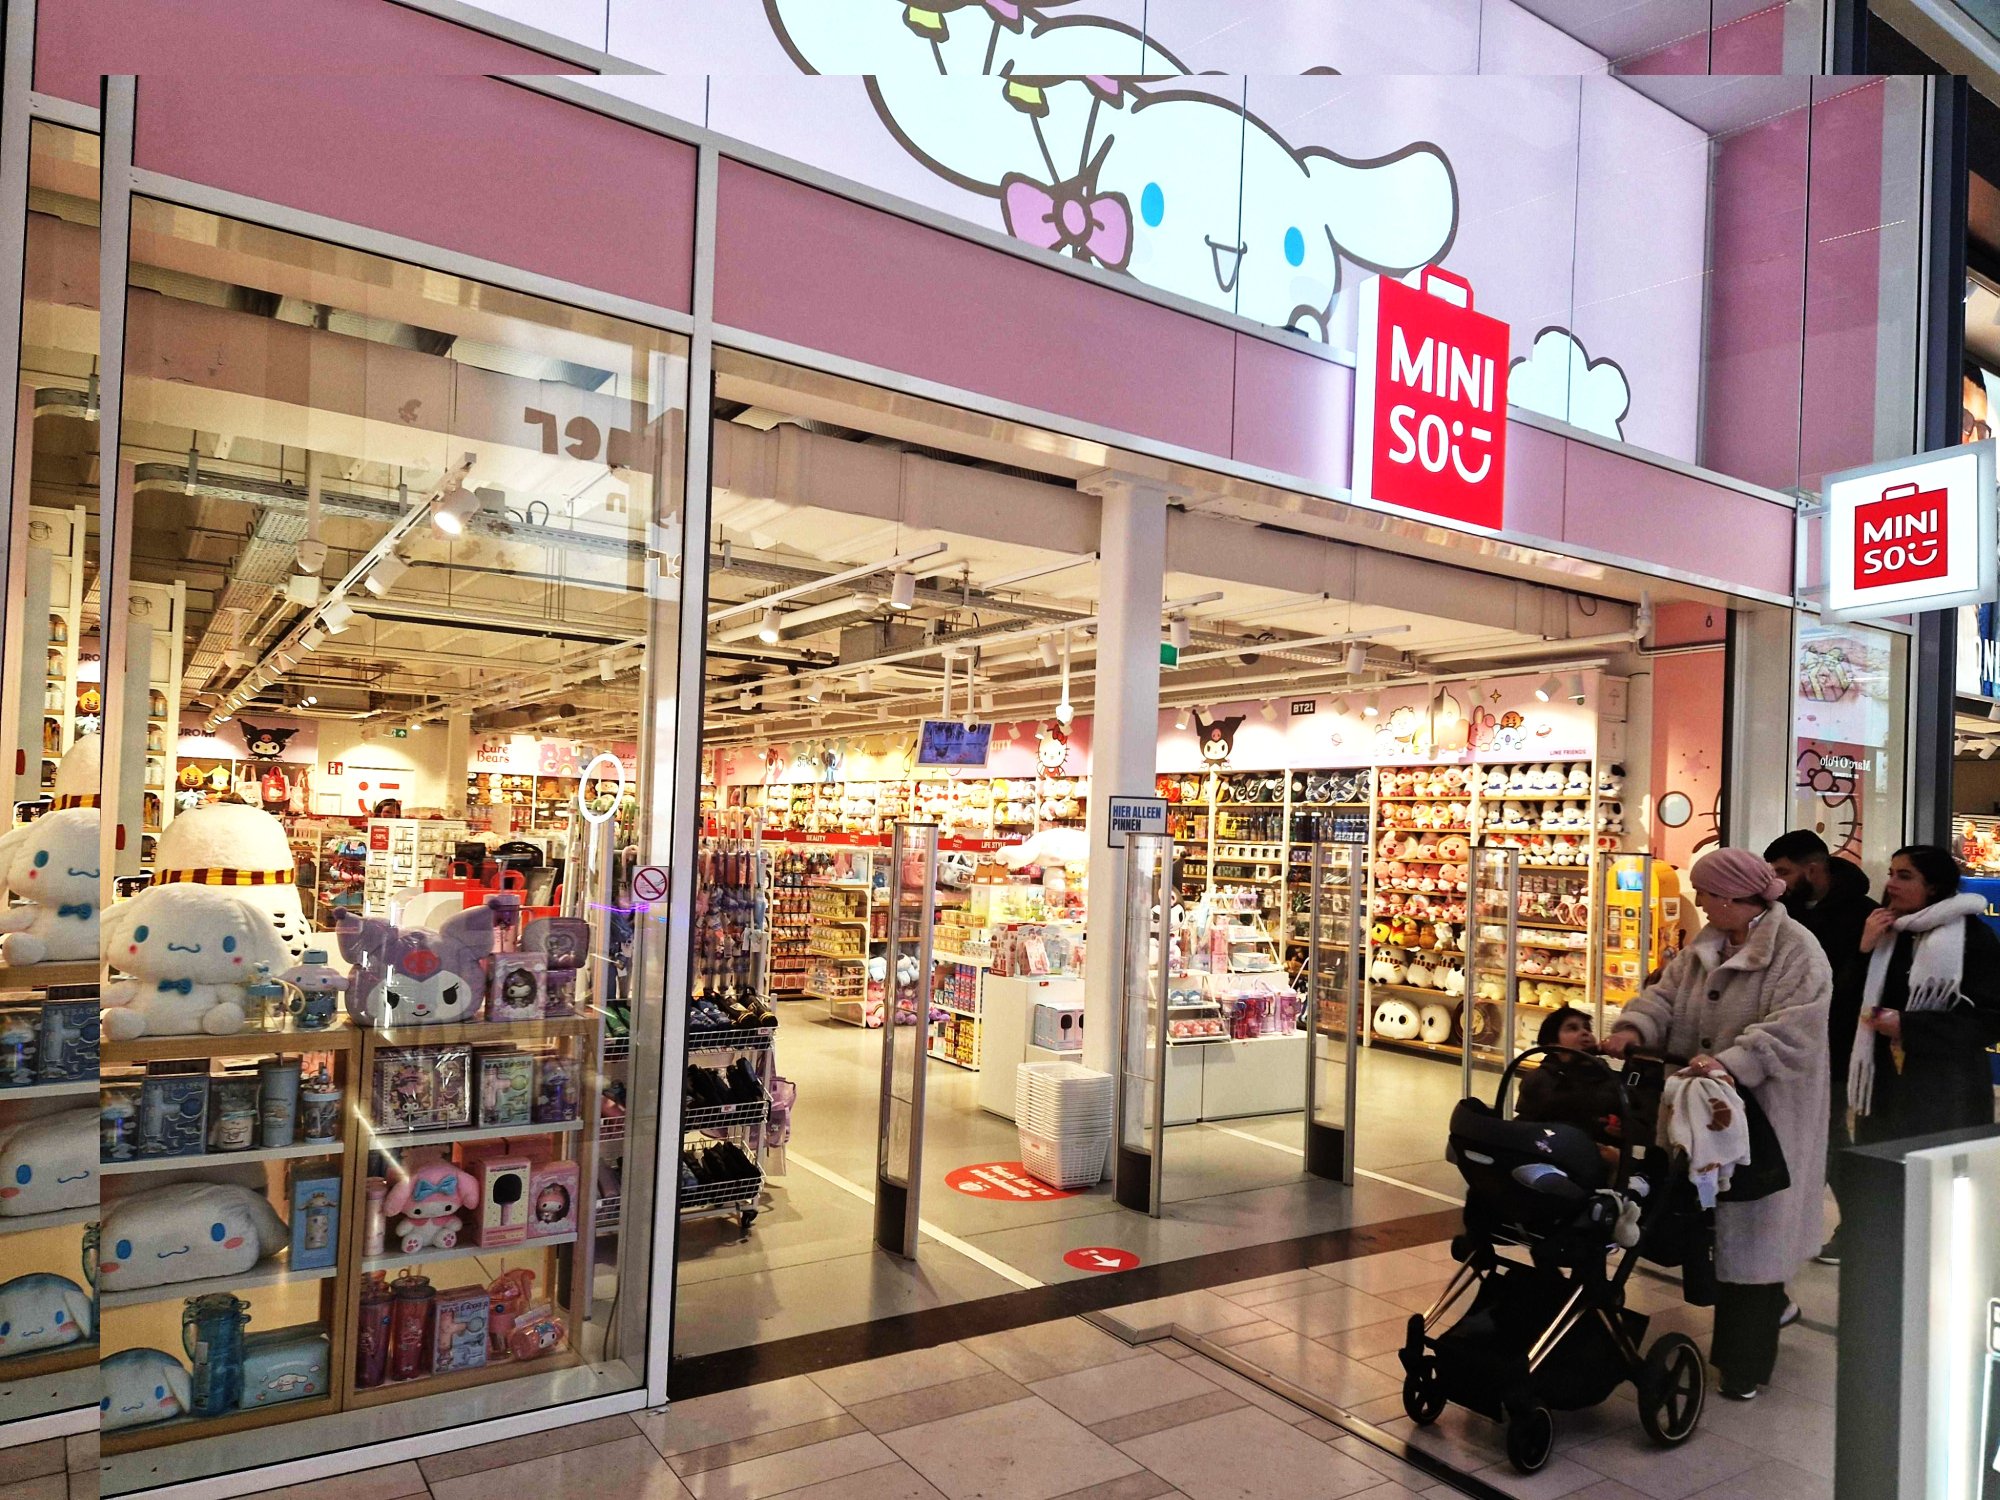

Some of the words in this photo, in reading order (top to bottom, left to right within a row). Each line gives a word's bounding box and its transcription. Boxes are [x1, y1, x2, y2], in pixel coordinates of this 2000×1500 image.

[1390, 324, 1495, 413] MINI
[1863, 508, 1938, 545] MINI
[1293, 702, 1314, 714] BT21
[477, 749, 510, 763] Bears
[1112, 804, 1132, 818] HIER
[1132, 806, 1162, 819] ALLEEN
[1112, 818, 1142, 831] PINNEN
[805, 834, 827, 843] BEAUTY
[981, 841, 991, 849] LIFE
